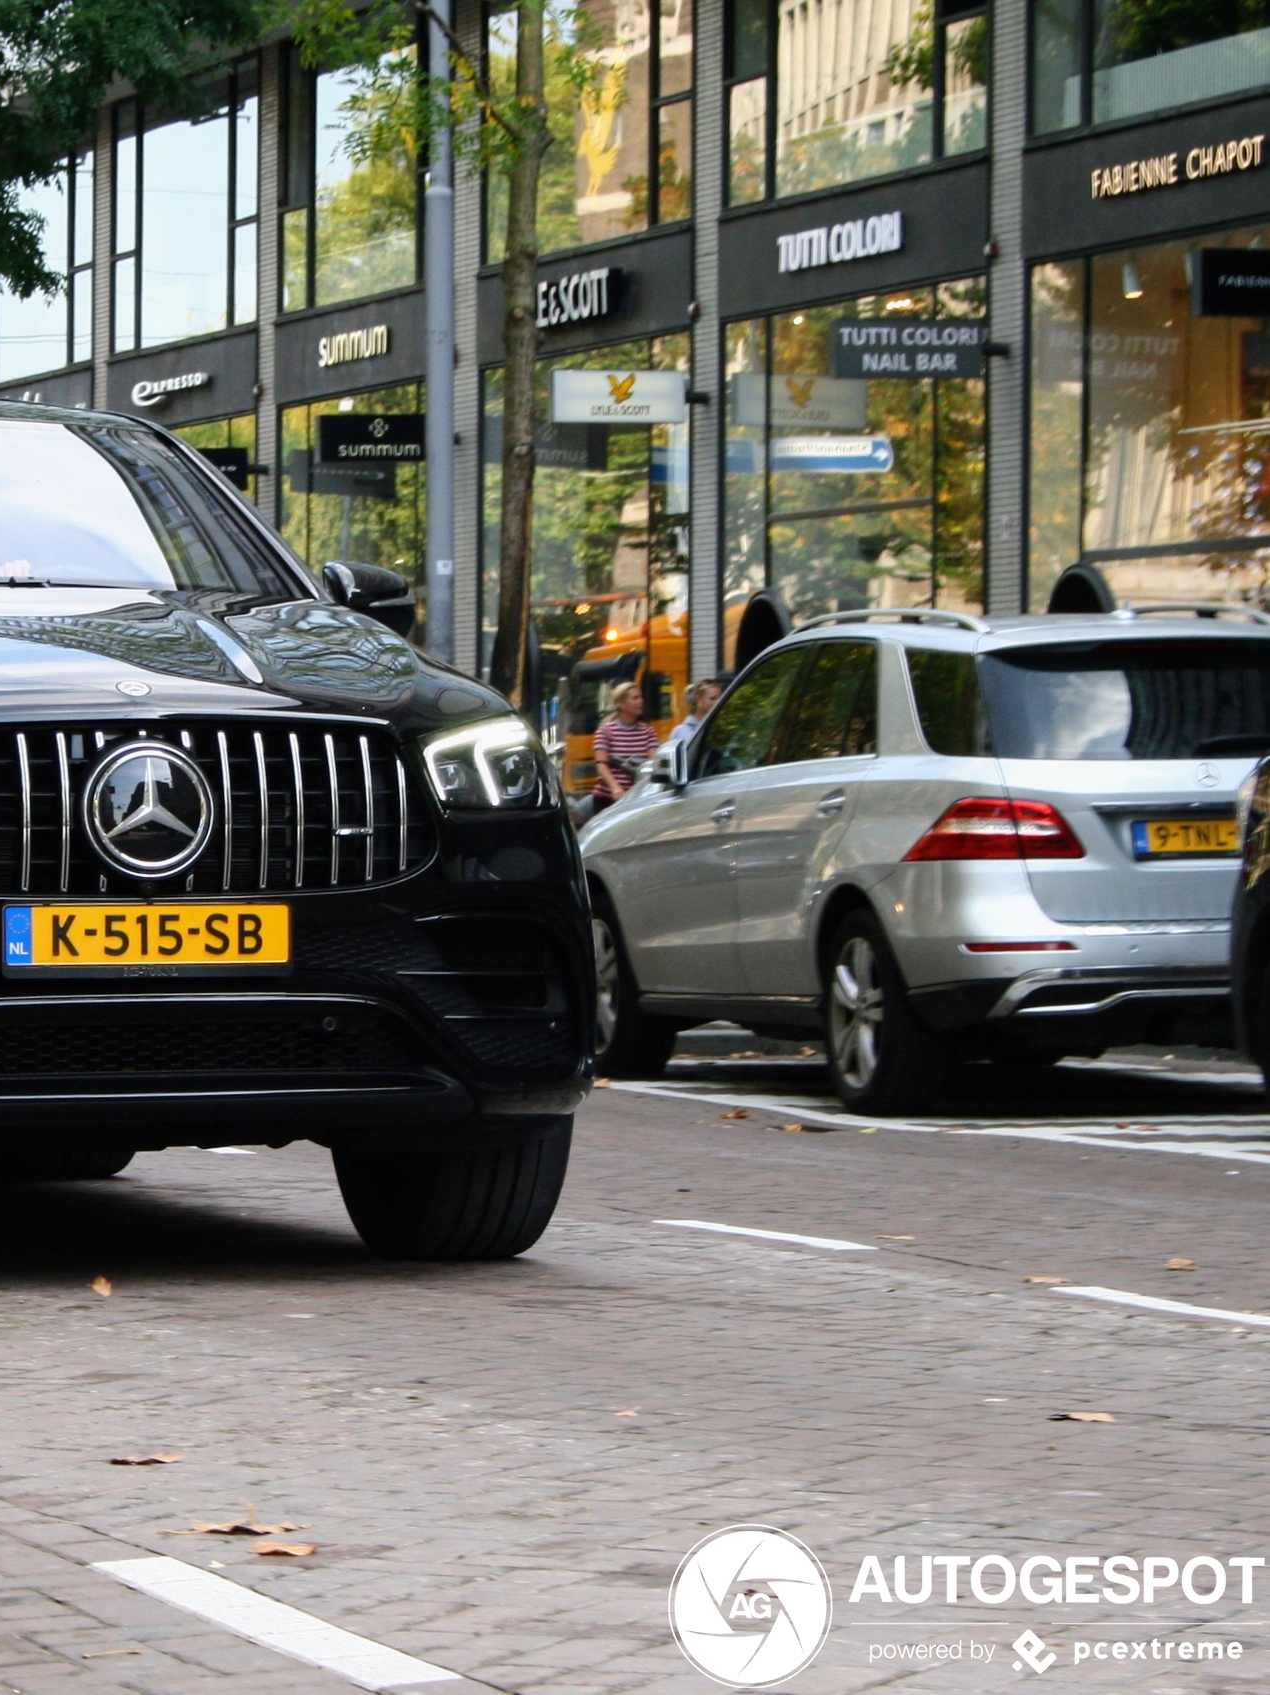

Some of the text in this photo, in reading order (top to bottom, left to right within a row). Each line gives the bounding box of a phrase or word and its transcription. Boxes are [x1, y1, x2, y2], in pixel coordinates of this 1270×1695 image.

[1091, 134, 1266, 199] FABIENNE CHAPOT
[777, 211, 903, 273] TUTTI COLORI
[318, 325, 388, 367] summum
[839, 326, 978, 346] TUTTI COLORI
[862, 353, 958, 371] NAIL BAR
[338, 444, 421, 457] summum
[9, 943, 29, 955] NL
[51, 913, 263, 957] K-515-SB
